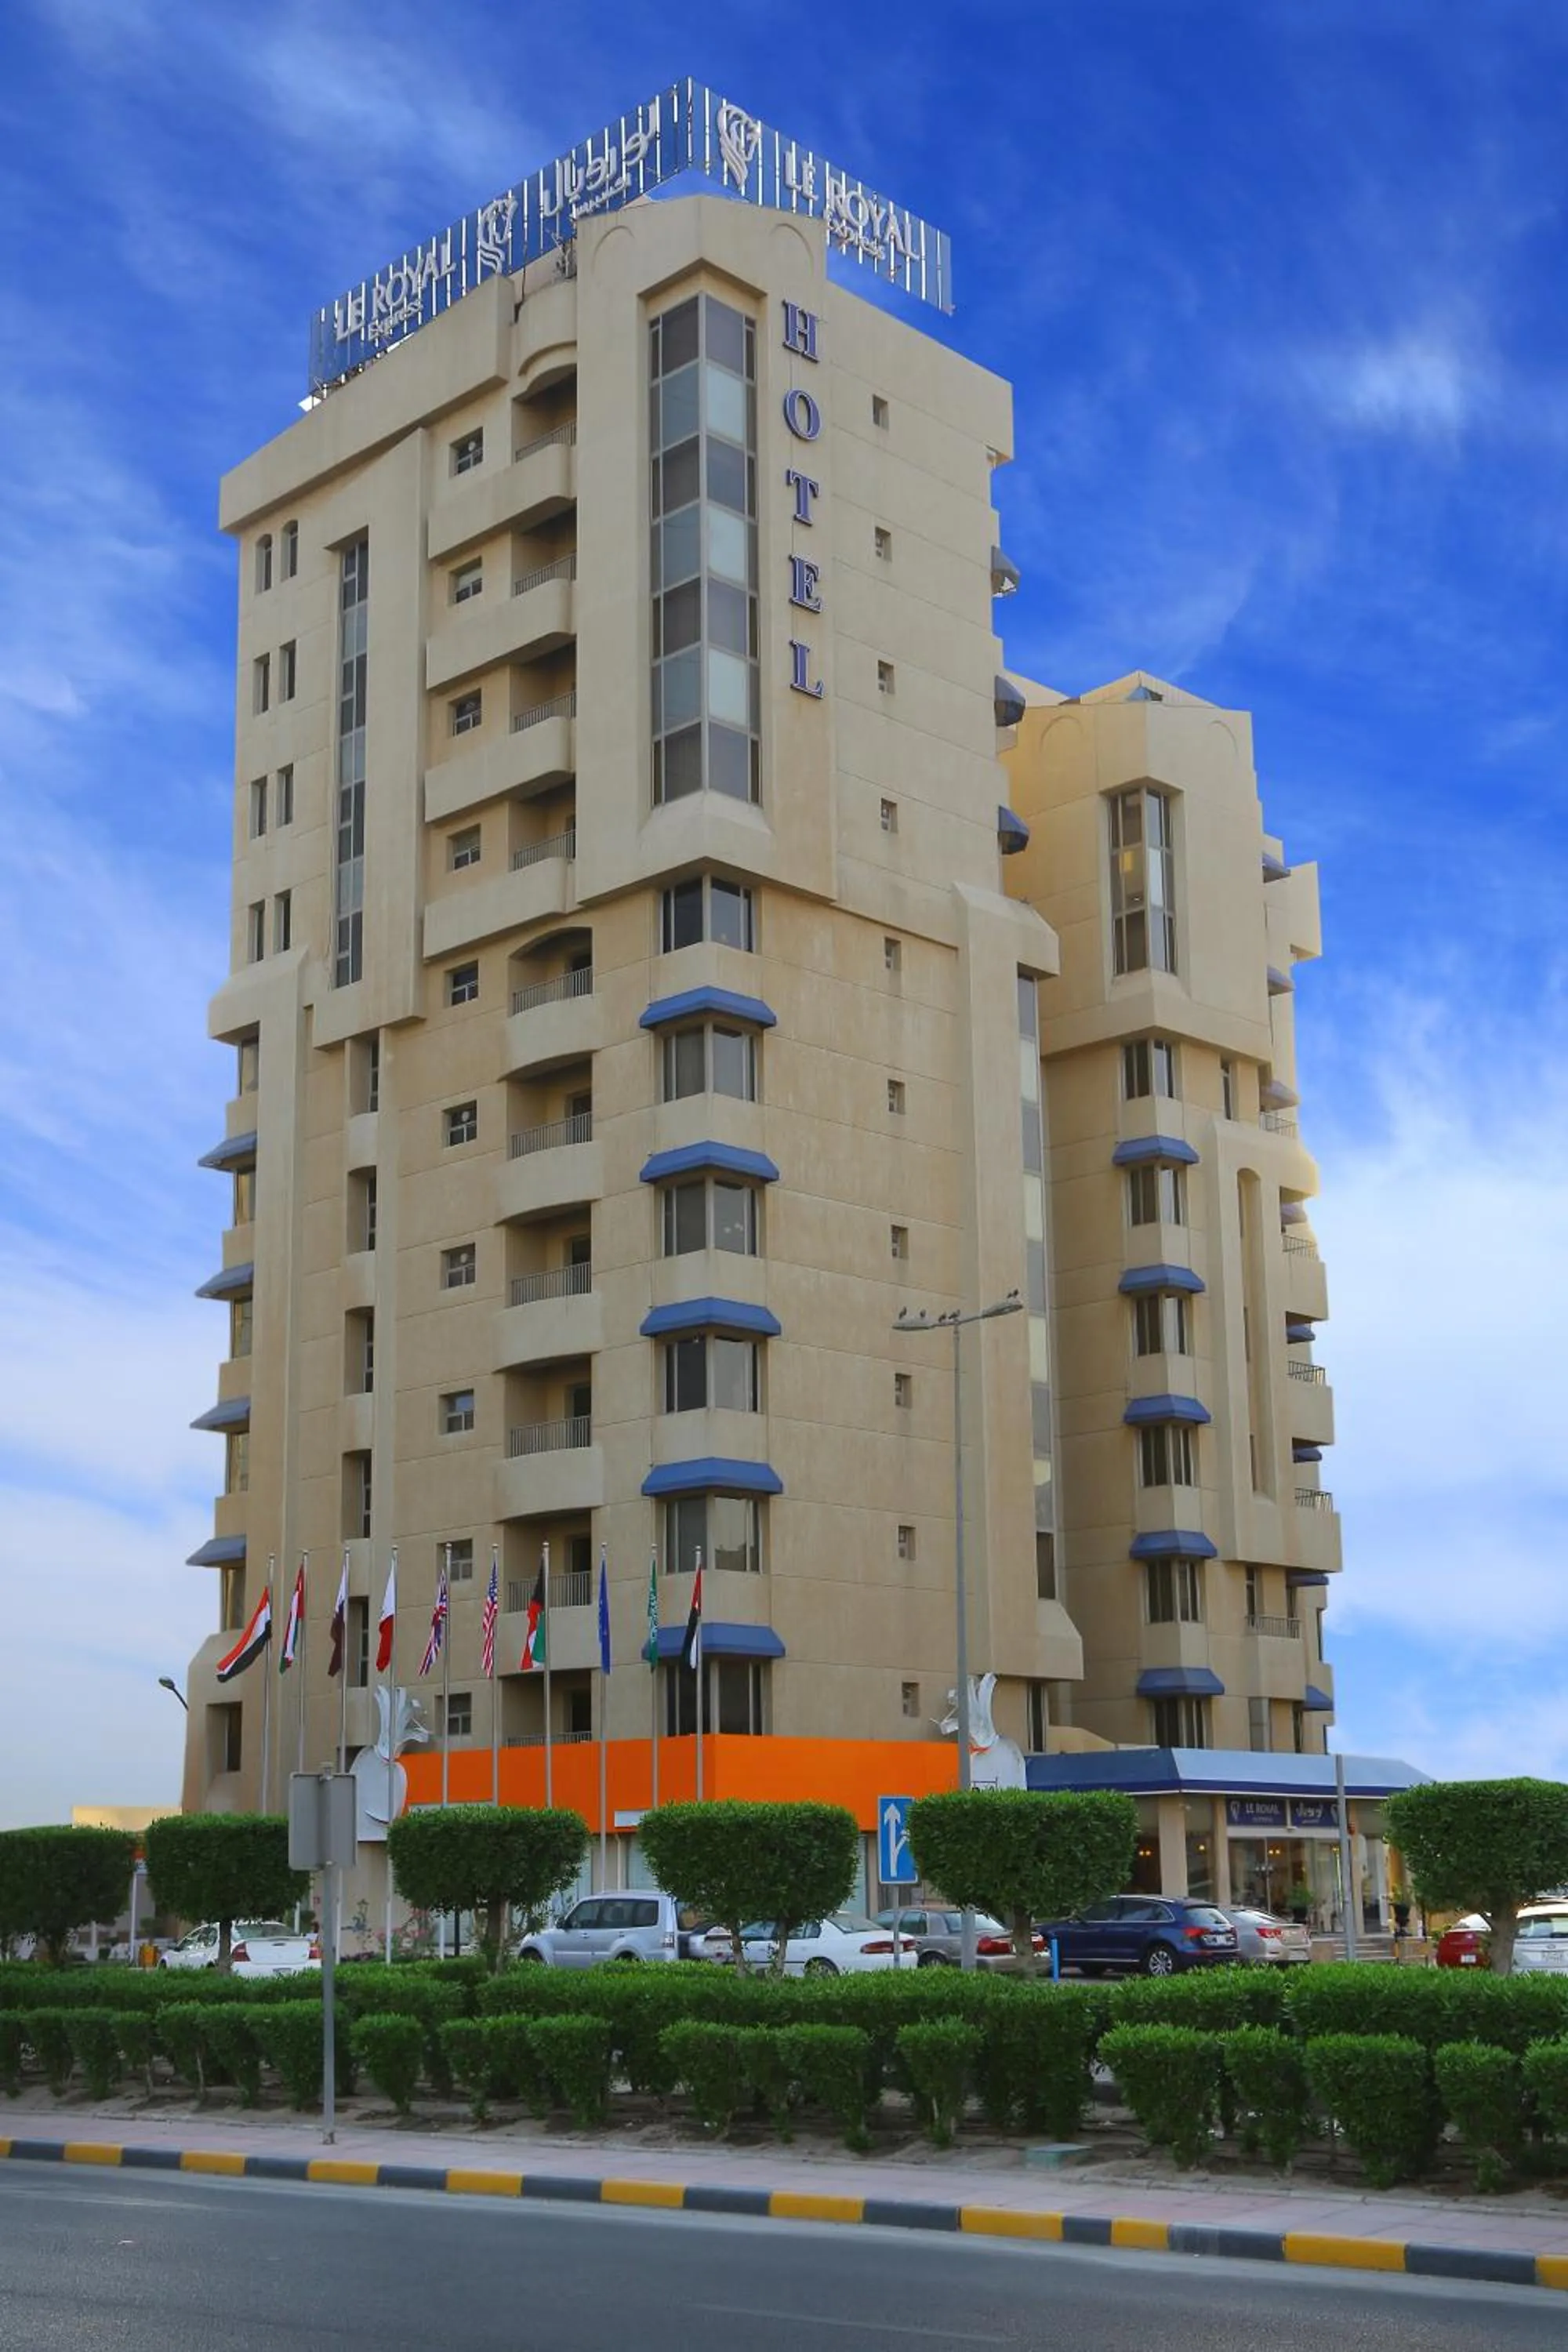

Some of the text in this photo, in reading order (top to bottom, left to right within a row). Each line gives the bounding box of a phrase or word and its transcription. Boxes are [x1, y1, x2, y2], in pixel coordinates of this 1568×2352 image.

[785, 151, 920, 260] LE ROYAL
[336, 242, 457, 342] LE ROYAL
[782, 299, 824, 700] HOTEL
